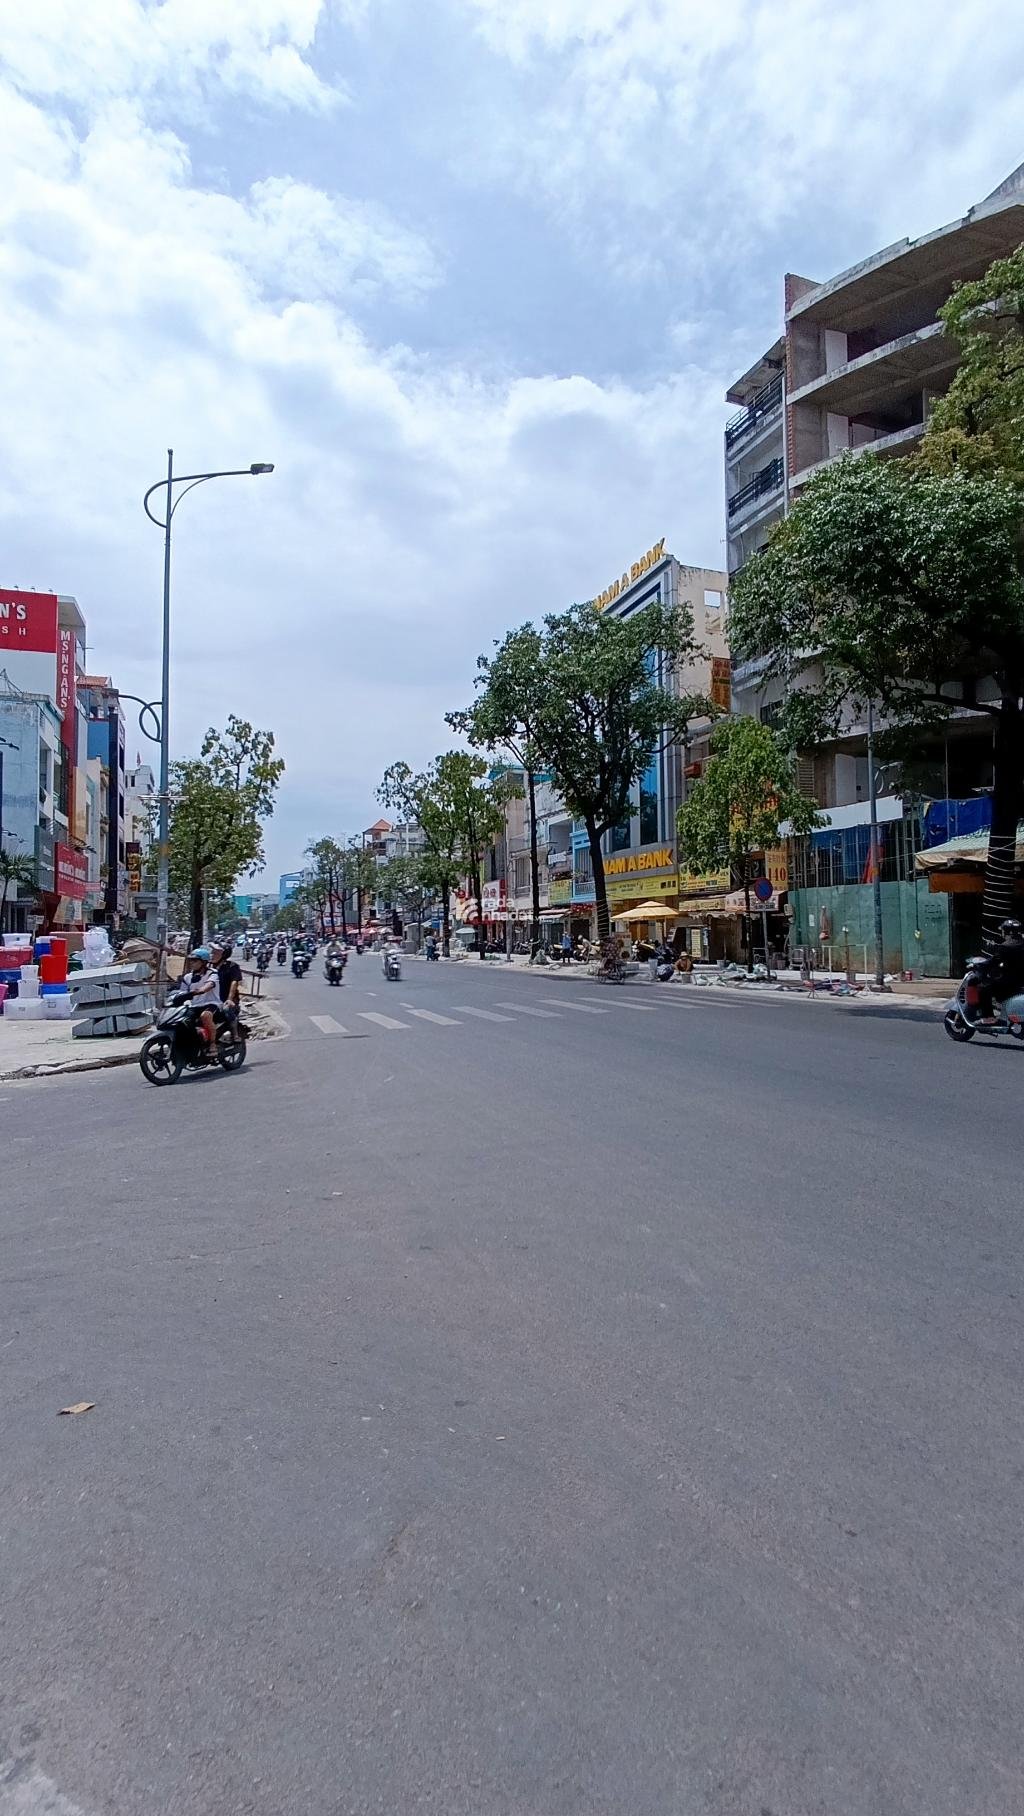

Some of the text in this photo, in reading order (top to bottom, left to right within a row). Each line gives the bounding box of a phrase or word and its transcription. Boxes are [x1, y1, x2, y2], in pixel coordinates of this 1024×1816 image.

[620, 572, 629, 592] A
[630, 537, 666, 582] BANK
[628, 855, 637, 872] A
[638, 848, 673, 870] BANK
